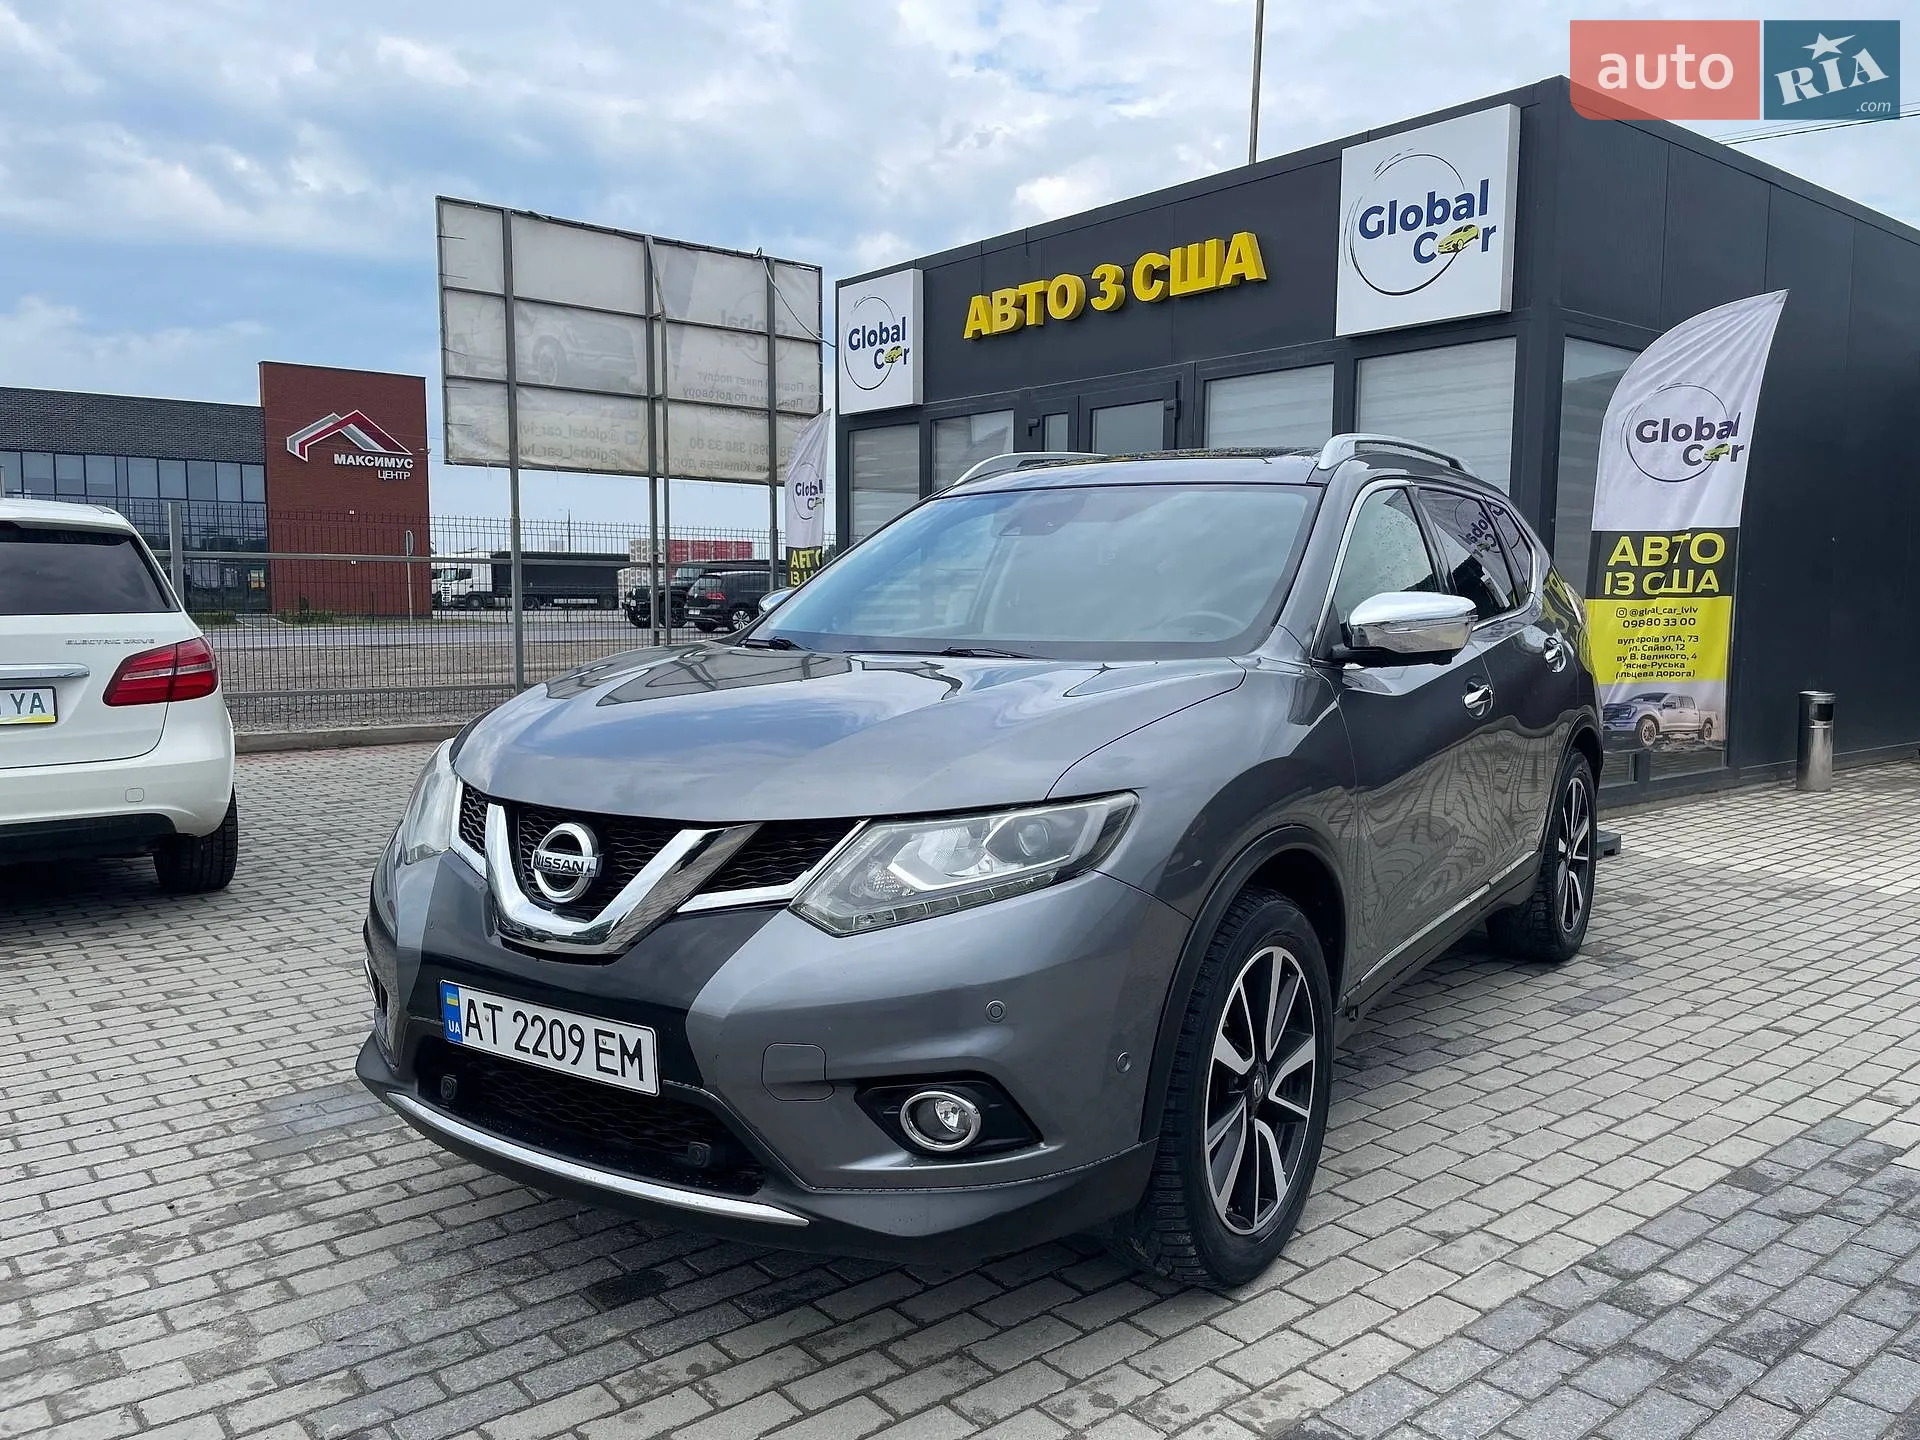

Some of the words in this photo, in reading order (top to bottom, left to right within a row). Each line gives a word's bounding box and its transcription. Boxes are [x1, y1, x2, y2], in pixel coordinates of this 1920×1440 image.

[1358, 178, 1489, 240] Global
[1413, 224, 1497, 264] Cr
[963, 272, 1086, 340] АВТО
[1131, 231, 1267, 302] США
[848, 316, 906, 351] Global
[873, 346, 910, 369] Cr
[1635, 411, 1741, 444] Global
[333, 453, 414, 469] МАКСИМУС
[1682, 443, 1744, 467] Cr
[377, 469, 411, 481] ЦЕНТР
[1607, 532, 1726, 567] АВТО
[1642, 568, 1719, 595] США
[1663, 618, 1677, 627] 33
[1679, 617, 1696, 626] 00
[64, 638, 121, 646] ELECTRIC
[1661, 634, 1685, 643] УПА,
[1687, 634, 1699, 643] 73
[1675, 643, 1686, 651] 12
[1690, 652, 1698, 660] 4
[533, 854, 585, 873] NISSAN
[448, 1018, 461, 1035] UA
[464, 999, 503, 1045] AT
[512, 1010, 585, 1066] 2209
[594, 1028, 644, 1082] EM
